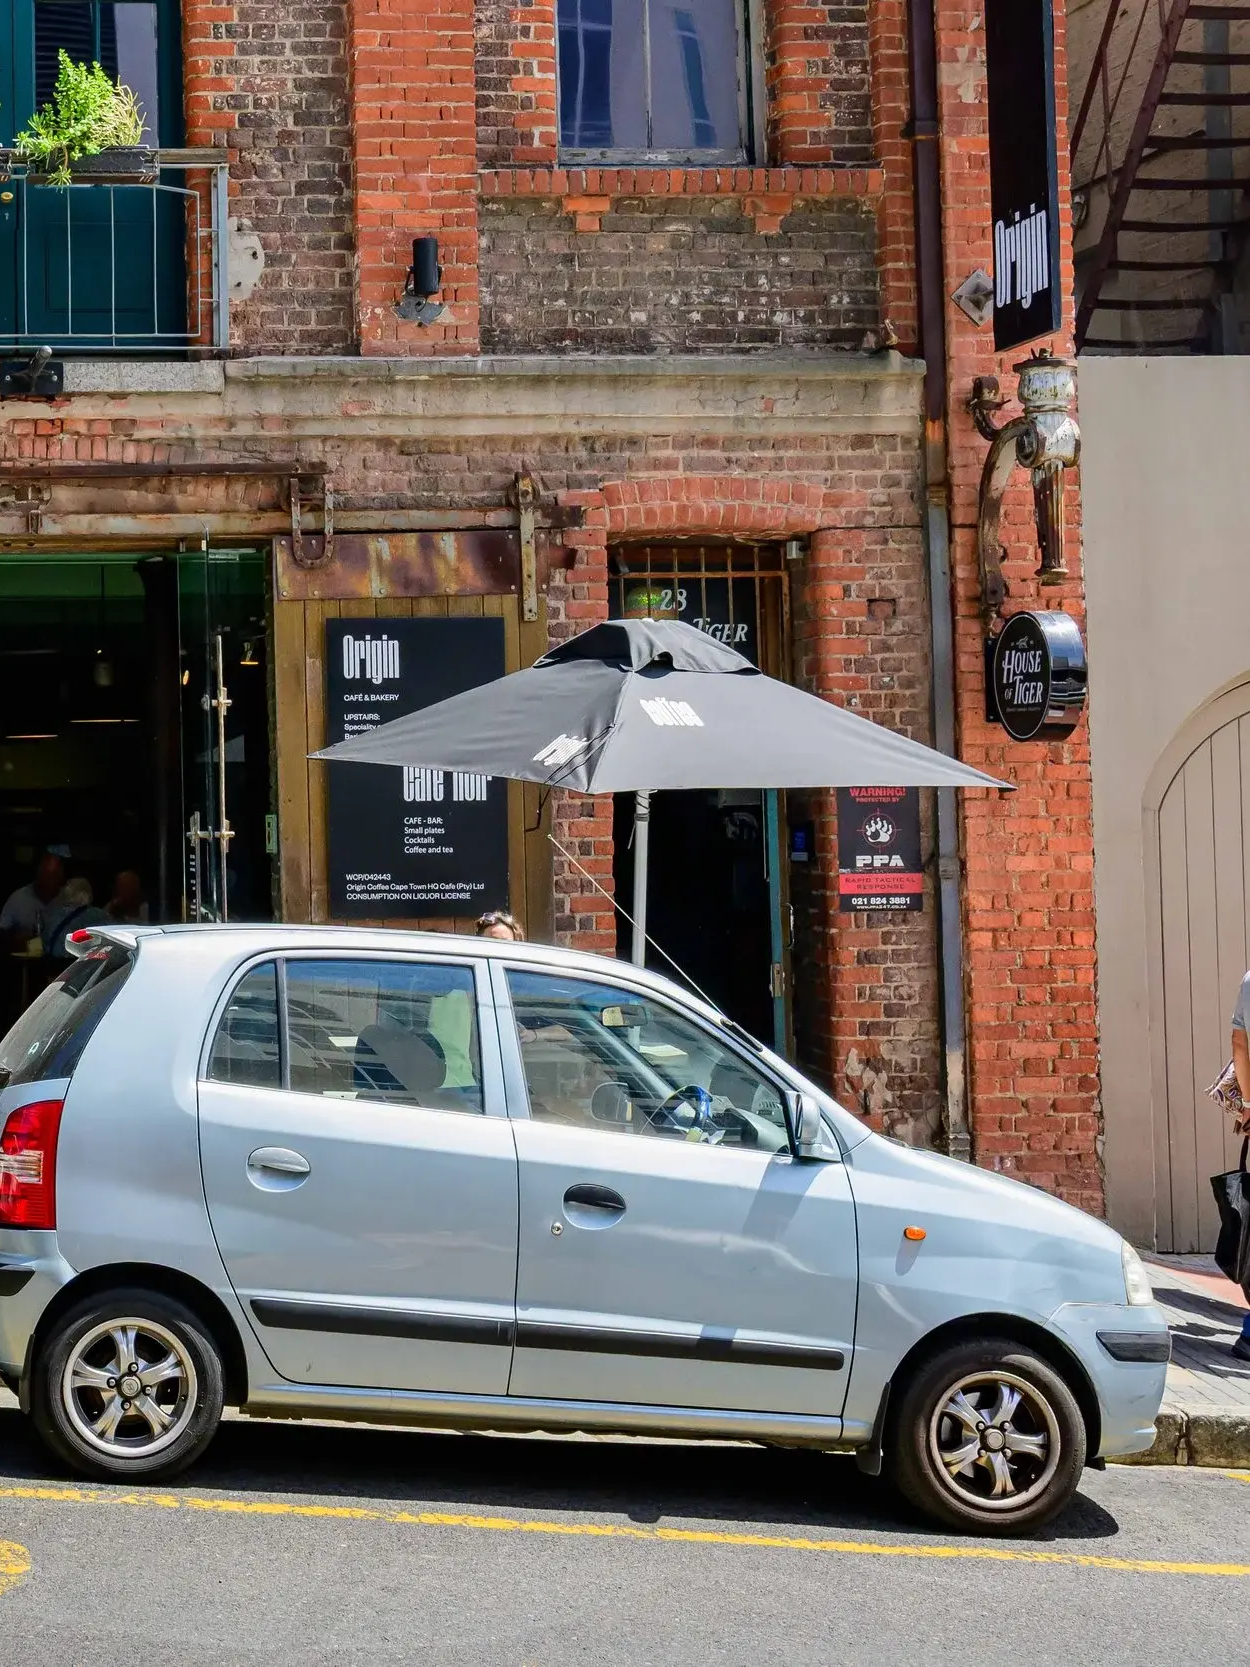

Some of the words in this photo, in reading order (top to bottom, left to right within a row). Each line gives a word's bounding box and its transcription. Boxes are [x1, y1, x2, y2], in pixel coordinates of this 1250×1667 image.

[995, 203, 1049, 309] Origin
[343, 634, 400, 685] Origin
[1002, 650, 1043, 684] HOUSE
[1013, 675, 1044, 705] TIGER
[343, 692, 364, 702] CAFÉ
[364, 694, 370, 702] &
[344, 713, 381, 721] UPSTAIRS:
[849, 787, 907, 797] WARNING!
[403, 816, 423, 825] CAFE
[427, 816, 444, 825] BAR:
[404, 826, 424, 834] Small
[424, 826, 446, 836] plates
[404, 836, 436, 844] Cocktails
[404, 846, 427, 854] Coffee
[427, 846, 442, 854] and
[442, 846, 454, 854] tea
[855, 854, 905, 868] PPA
[345, 873, 392, 881] WCP/042443
[346, 883, 367, 892] Origin
[367, 883, 390, 891] Coffee
[390, 883, 409, 892] Cape
[456, 882, 472, 892] (Pty)
[472, 882, 485, 890] Ltd
[413, 892, 440, 900] LIQUOR
[440, 892, 472, 900] LICENSE
[870, 897, 888, 905] 824
